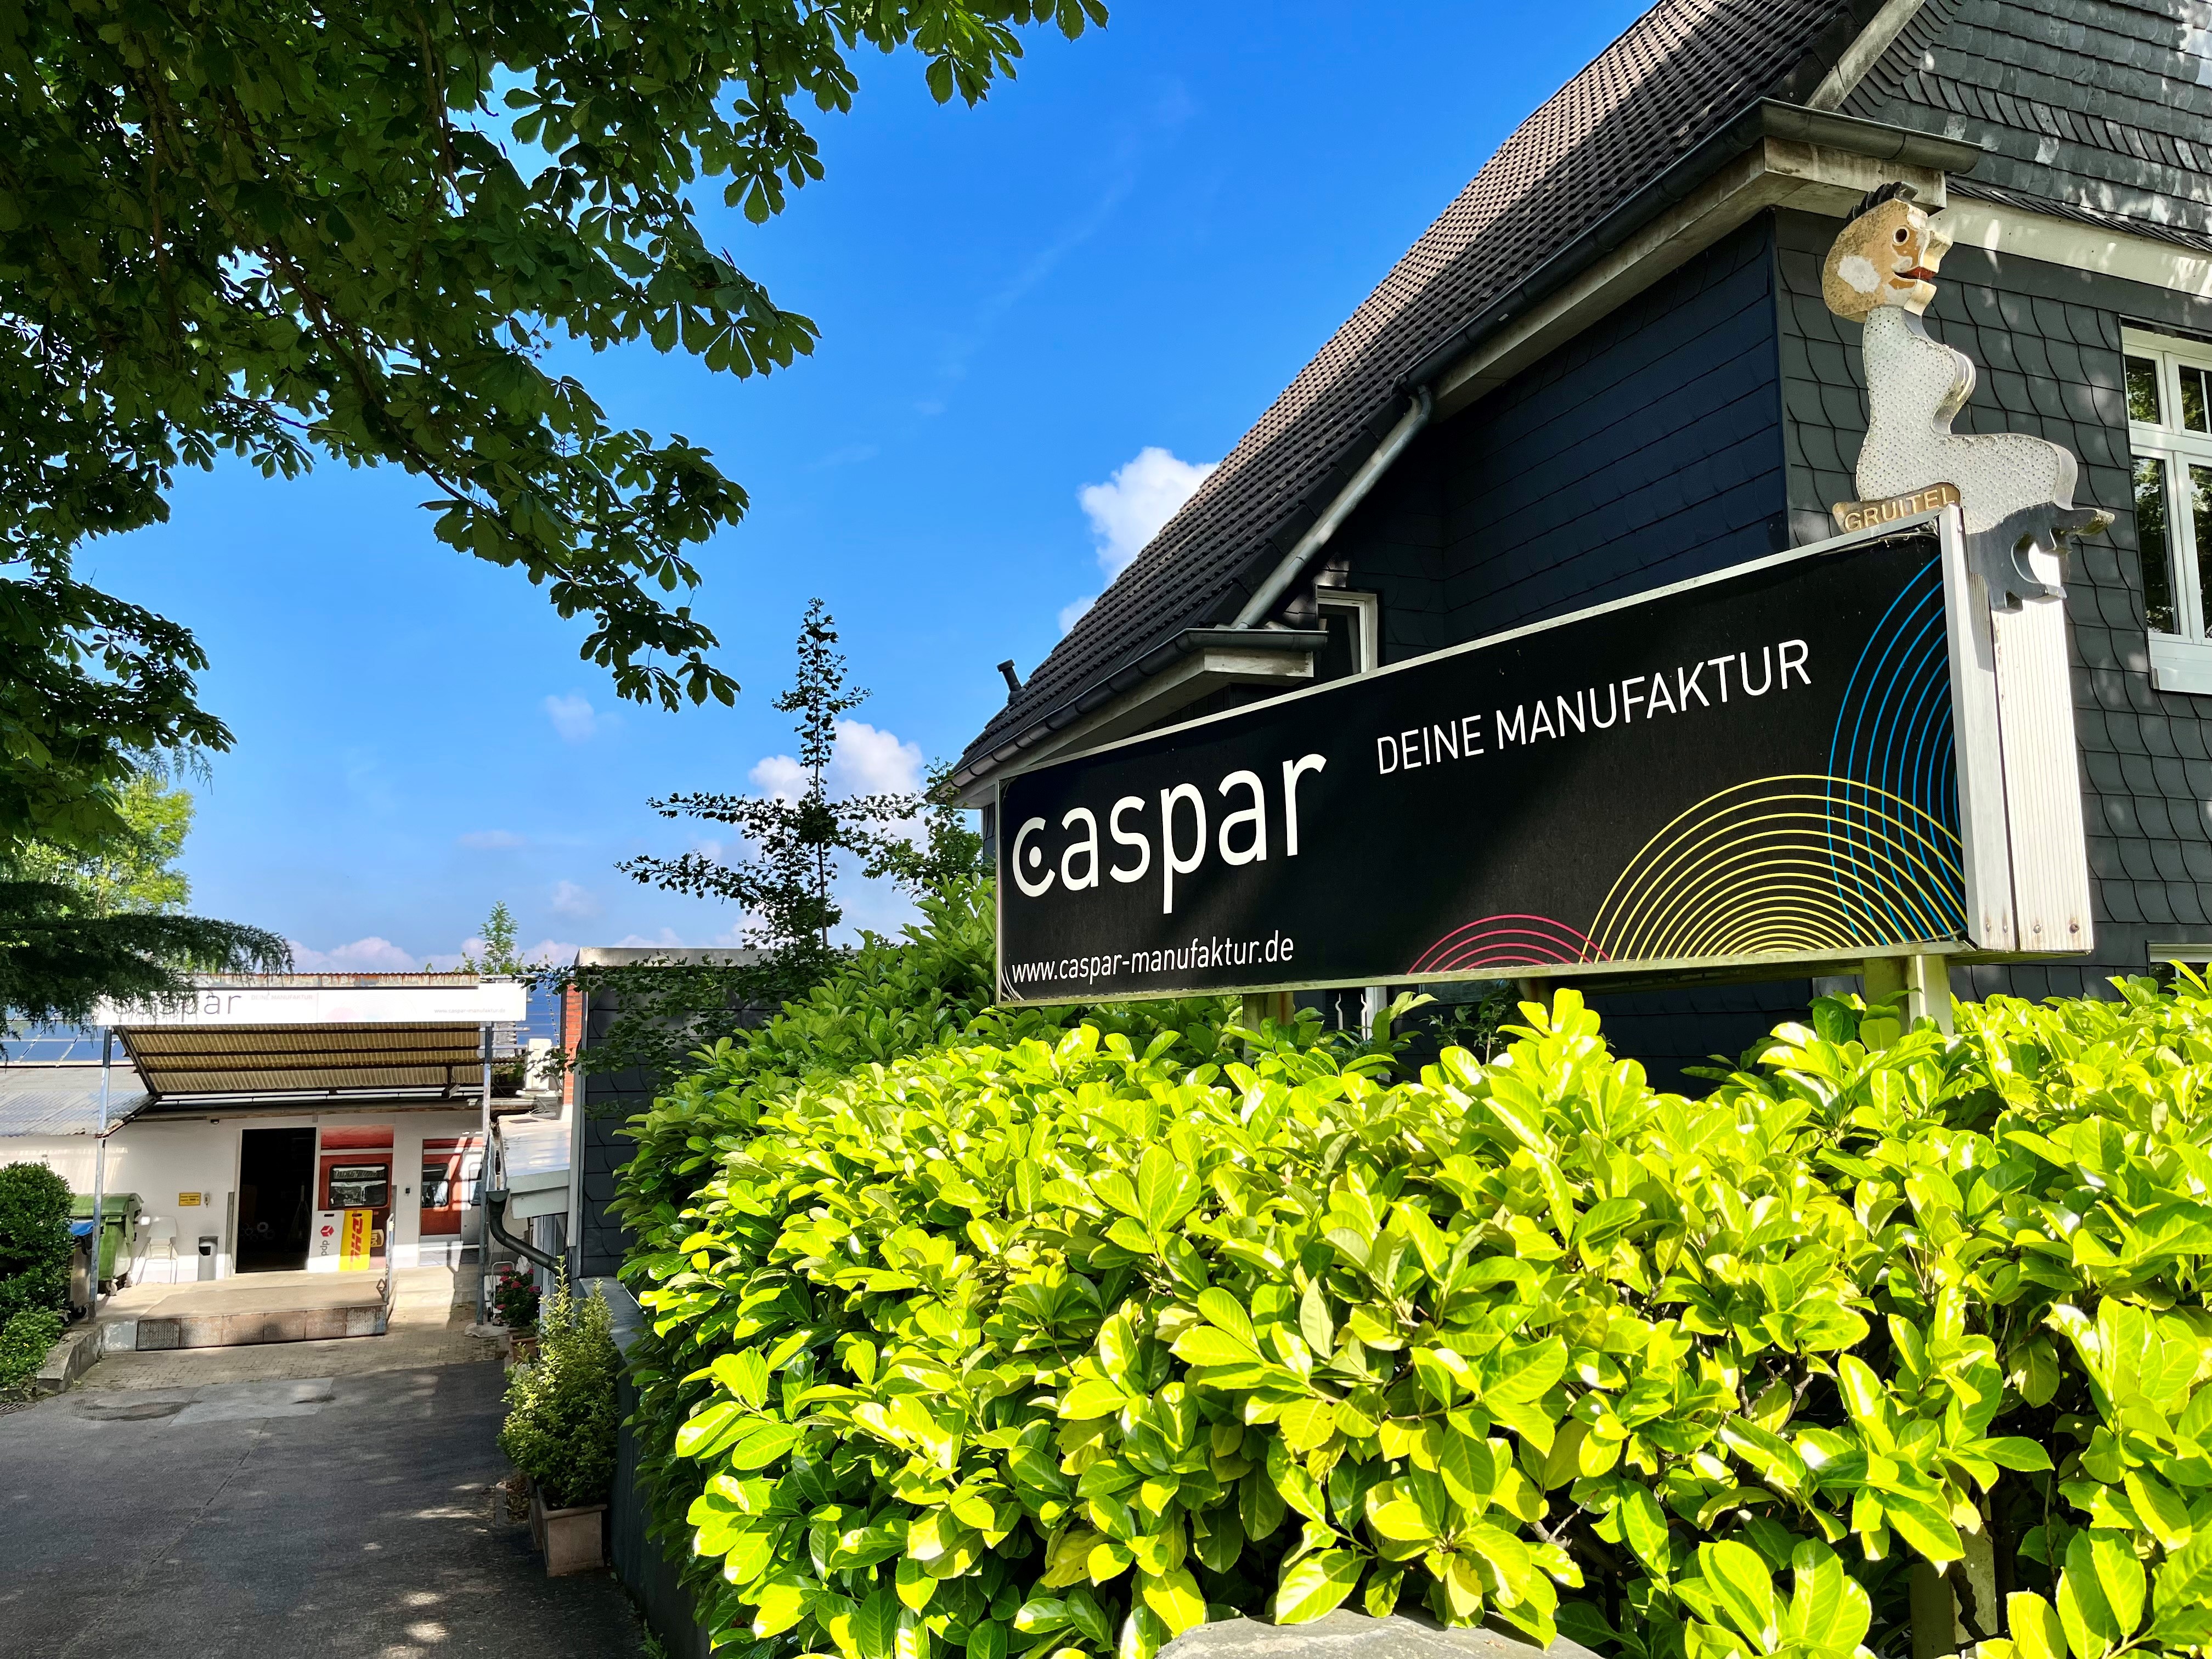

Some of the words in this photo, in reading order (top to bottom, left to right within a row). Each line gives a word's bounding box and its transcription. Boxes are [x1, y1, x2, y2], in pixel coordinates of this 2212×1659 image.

[1844, 487, 1955, 531] GRUITEL
[1377, 714, 1485, 775] DEINE
[1496, 639, 1812, 750] MANUFAKTUR
[1012, 753, 1328, 915] caspar
[1012, 929, 1294, 986] www.caspar-manufaktur.de
[114, 992, 242, 1023] spar
[320, 1240, 330, 1256] dpd
[350, 1217, 364, 1262] DHL
